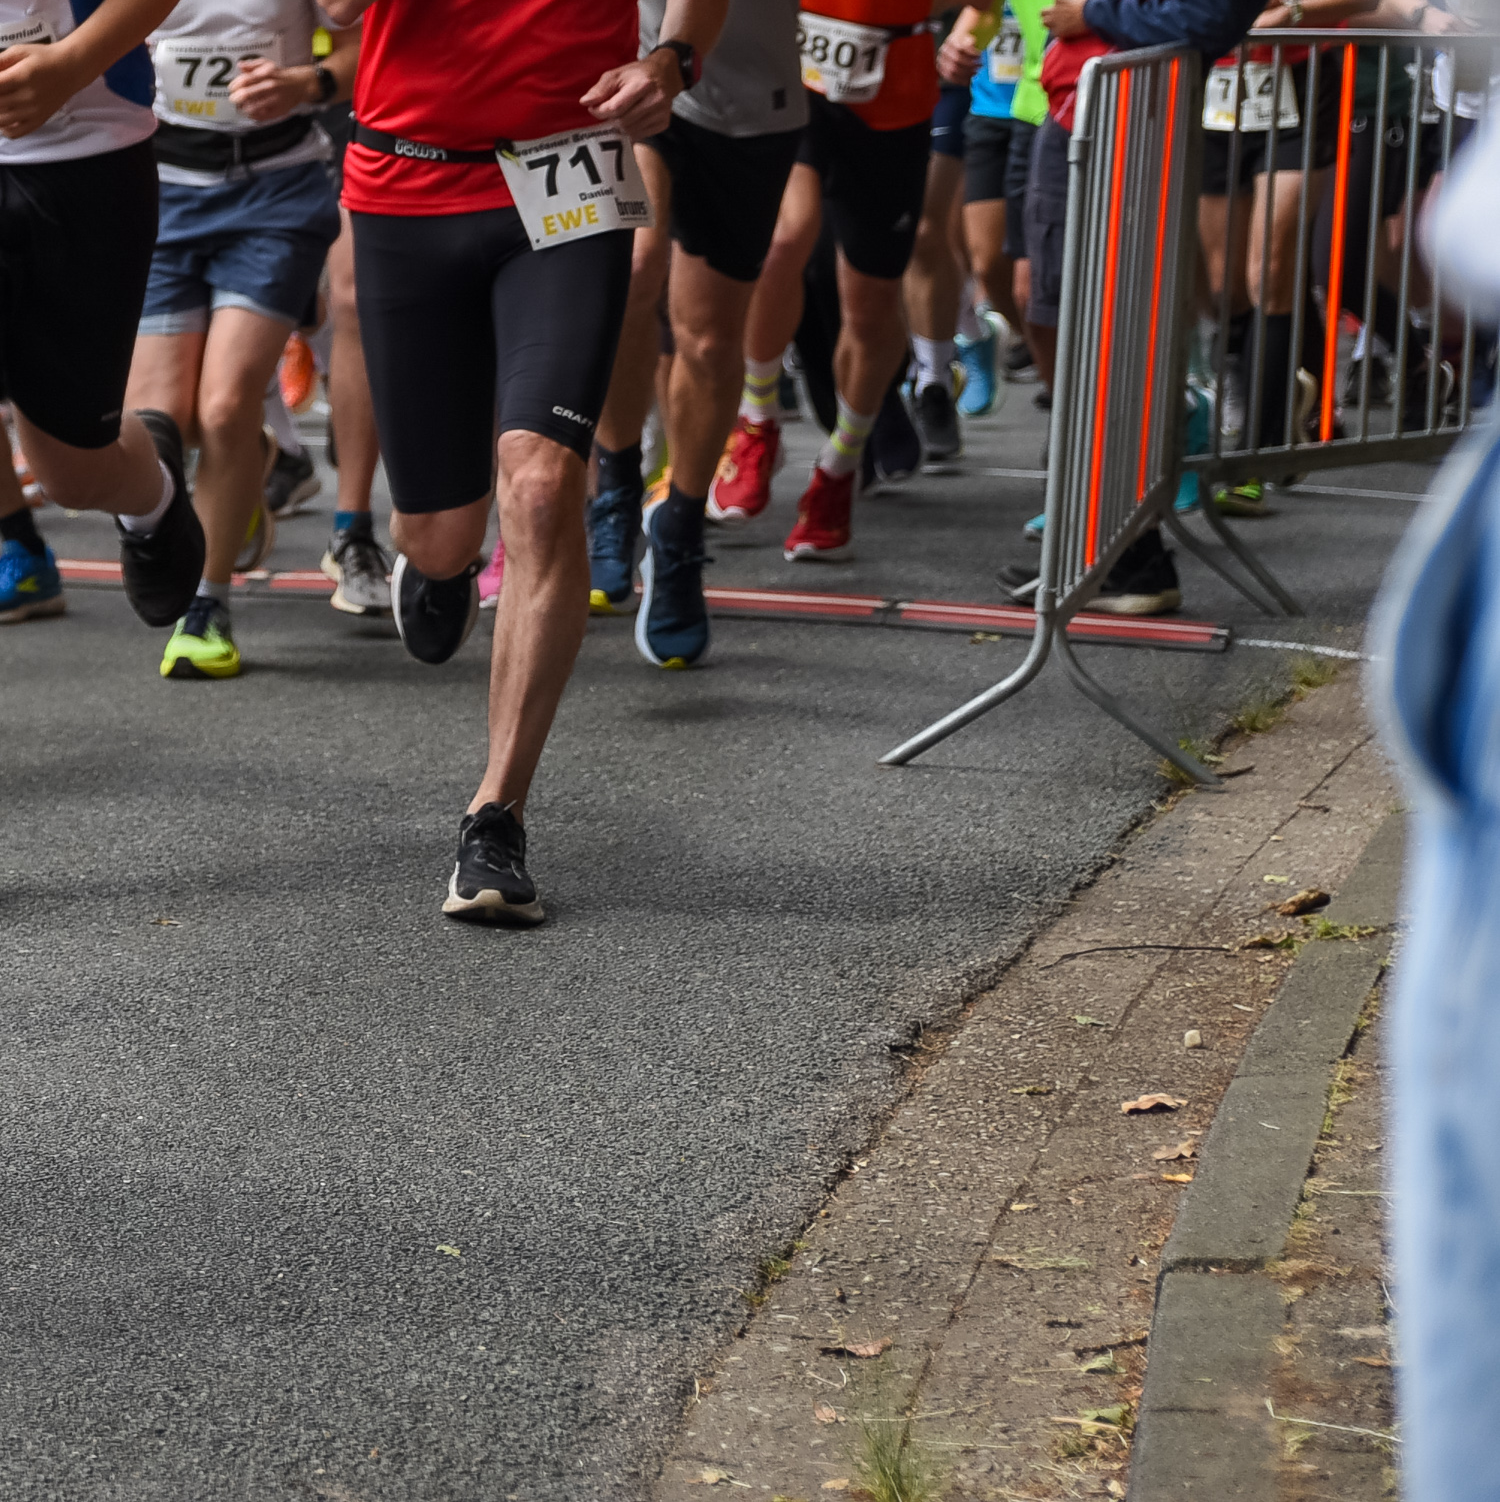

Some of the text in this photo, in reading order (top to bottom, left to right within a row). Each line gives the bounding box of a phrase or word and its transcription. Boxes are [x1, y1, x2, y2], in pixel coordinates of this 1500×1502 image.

[176, 54, 263, 87] 72
[526, 140, 624, 198] 717
[579, 188, 613, 201] Daniel
[615, 198, 647, 216] bruns
[542, 204, 598, 236] EWE
